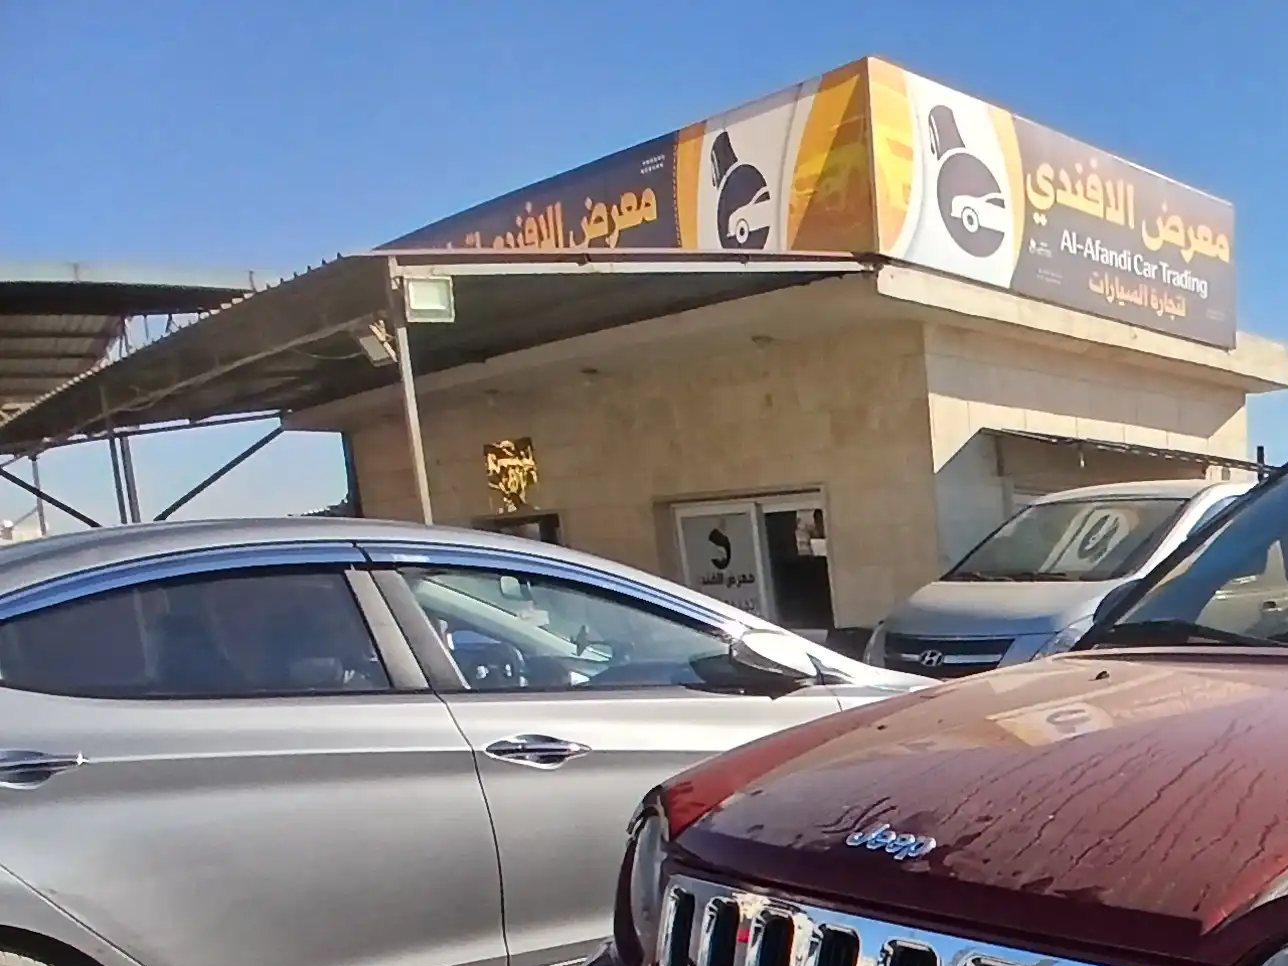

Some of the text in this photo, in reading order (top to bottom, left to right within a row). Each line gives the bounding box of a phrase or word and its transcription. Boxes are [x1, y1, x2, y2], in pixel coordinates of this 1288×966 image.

[569, 187, 658, 249] معرض
[1026, 157, 1230, 263] معرض الافندي
[1060, 229, 1132, 272] Al-Afandi
[1134, 253, 1158, 279] Car
[1159, 261, 1208, 299] Trading
[1088, 271, 1149, 306] السيارات
[846, 824, 936, 860] Jeep
